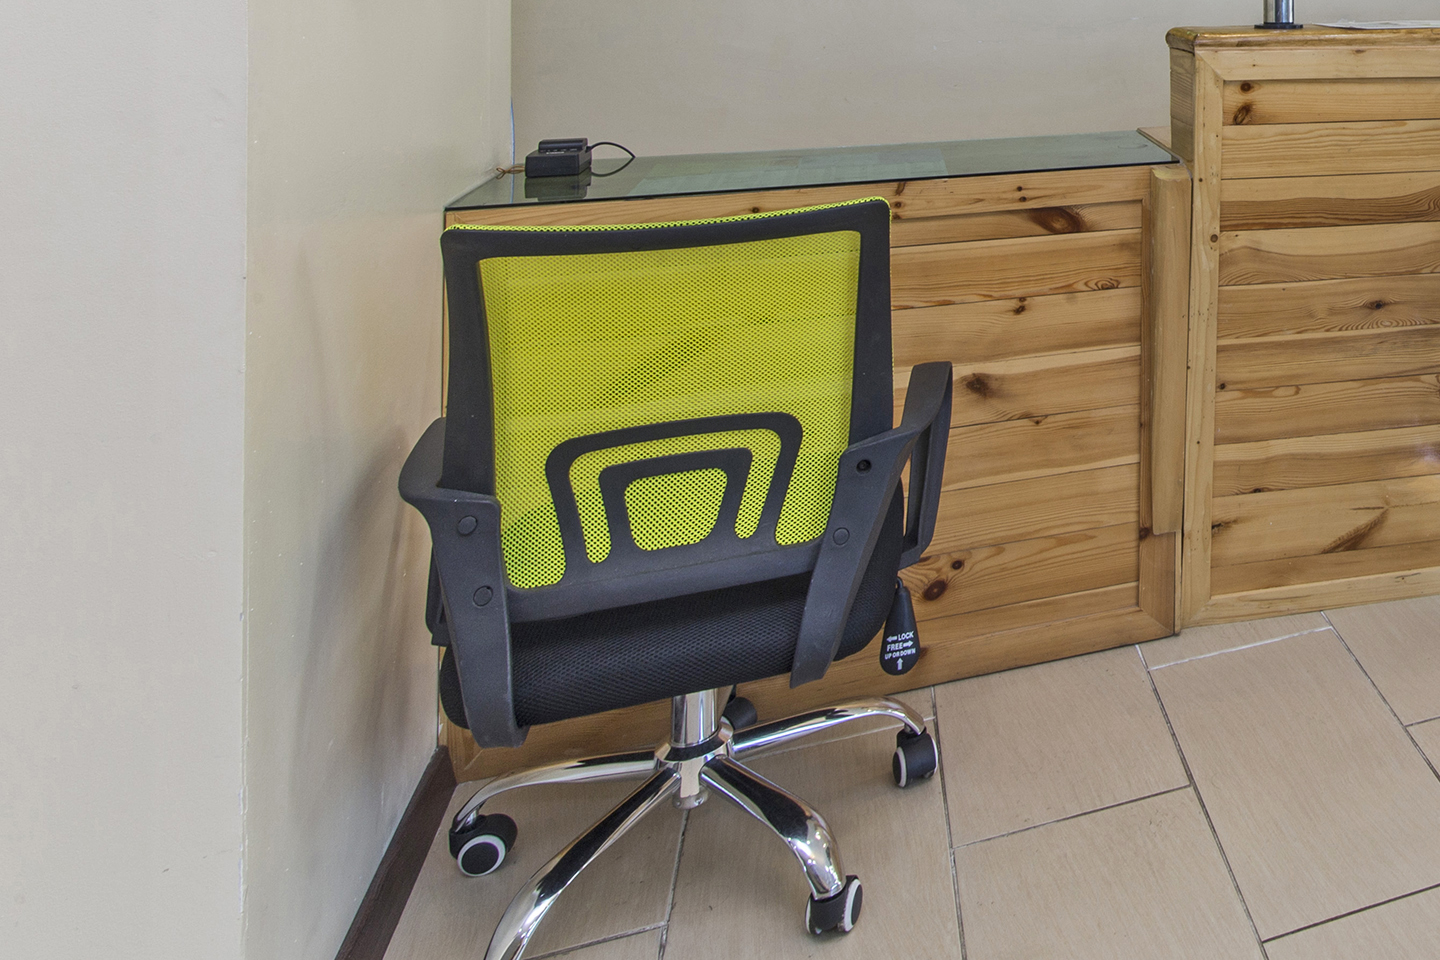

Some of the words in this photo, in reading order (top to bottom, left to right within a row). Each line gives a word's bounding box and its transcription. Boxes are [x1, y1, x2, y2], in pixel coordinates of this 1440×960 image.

[898, 631, 914, 641] LOCK
[887, 642, 903, 652] FREE
[892, 651, 900, 659] OR
[900, 648, 916, 656] DOWN
